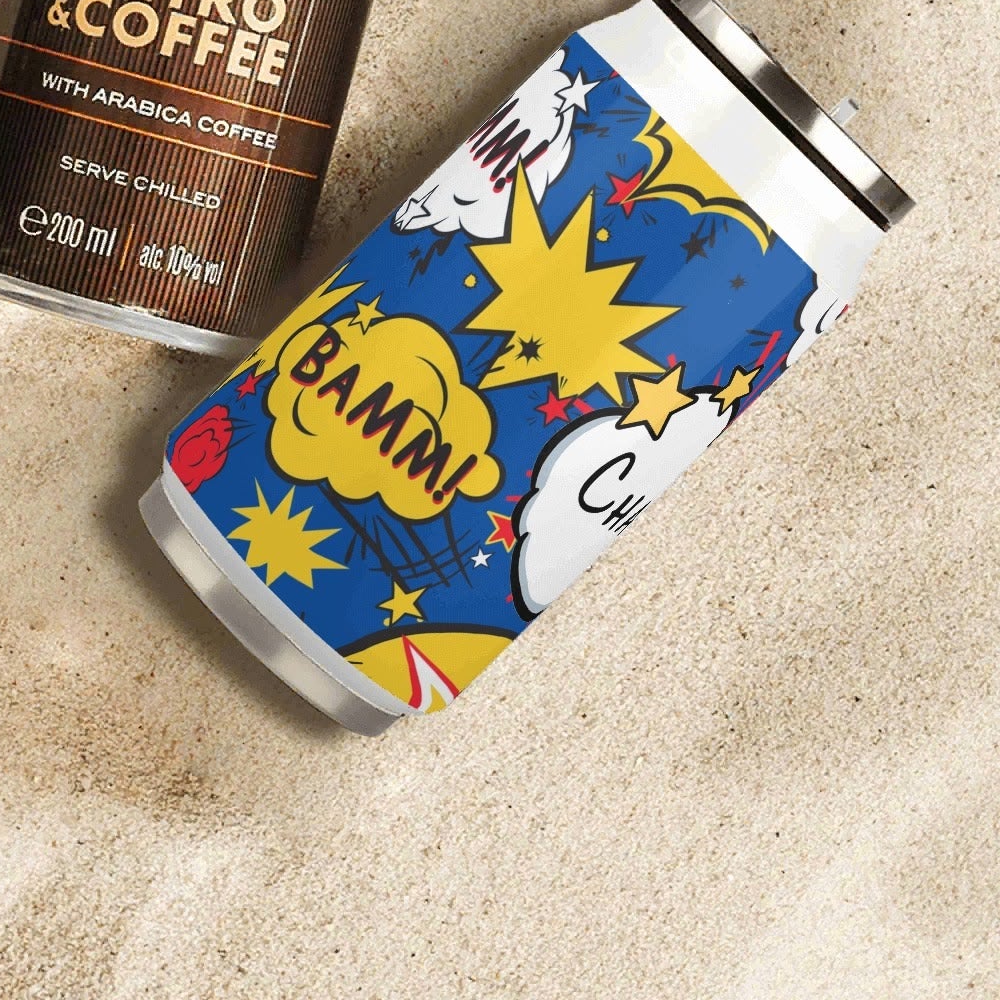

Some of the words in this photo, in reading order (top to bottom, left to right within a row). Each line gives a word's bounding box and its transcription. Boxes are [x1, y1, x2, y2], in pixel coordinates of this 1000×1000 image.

[42, 71, 90, 99] WITH
[92, 88, 192, 128] ARABICA
[198, 116, 279, 150] COFFEE
[59, 155, 129, 187] SERVE
[134, 176, 221, 210] CHILLED
[85, 226, 118, 257] ml
[139, 243, 163, 271] alc.
[202, 260, 225, 287] vol
[290, 325, 478, 505] BAMM!
